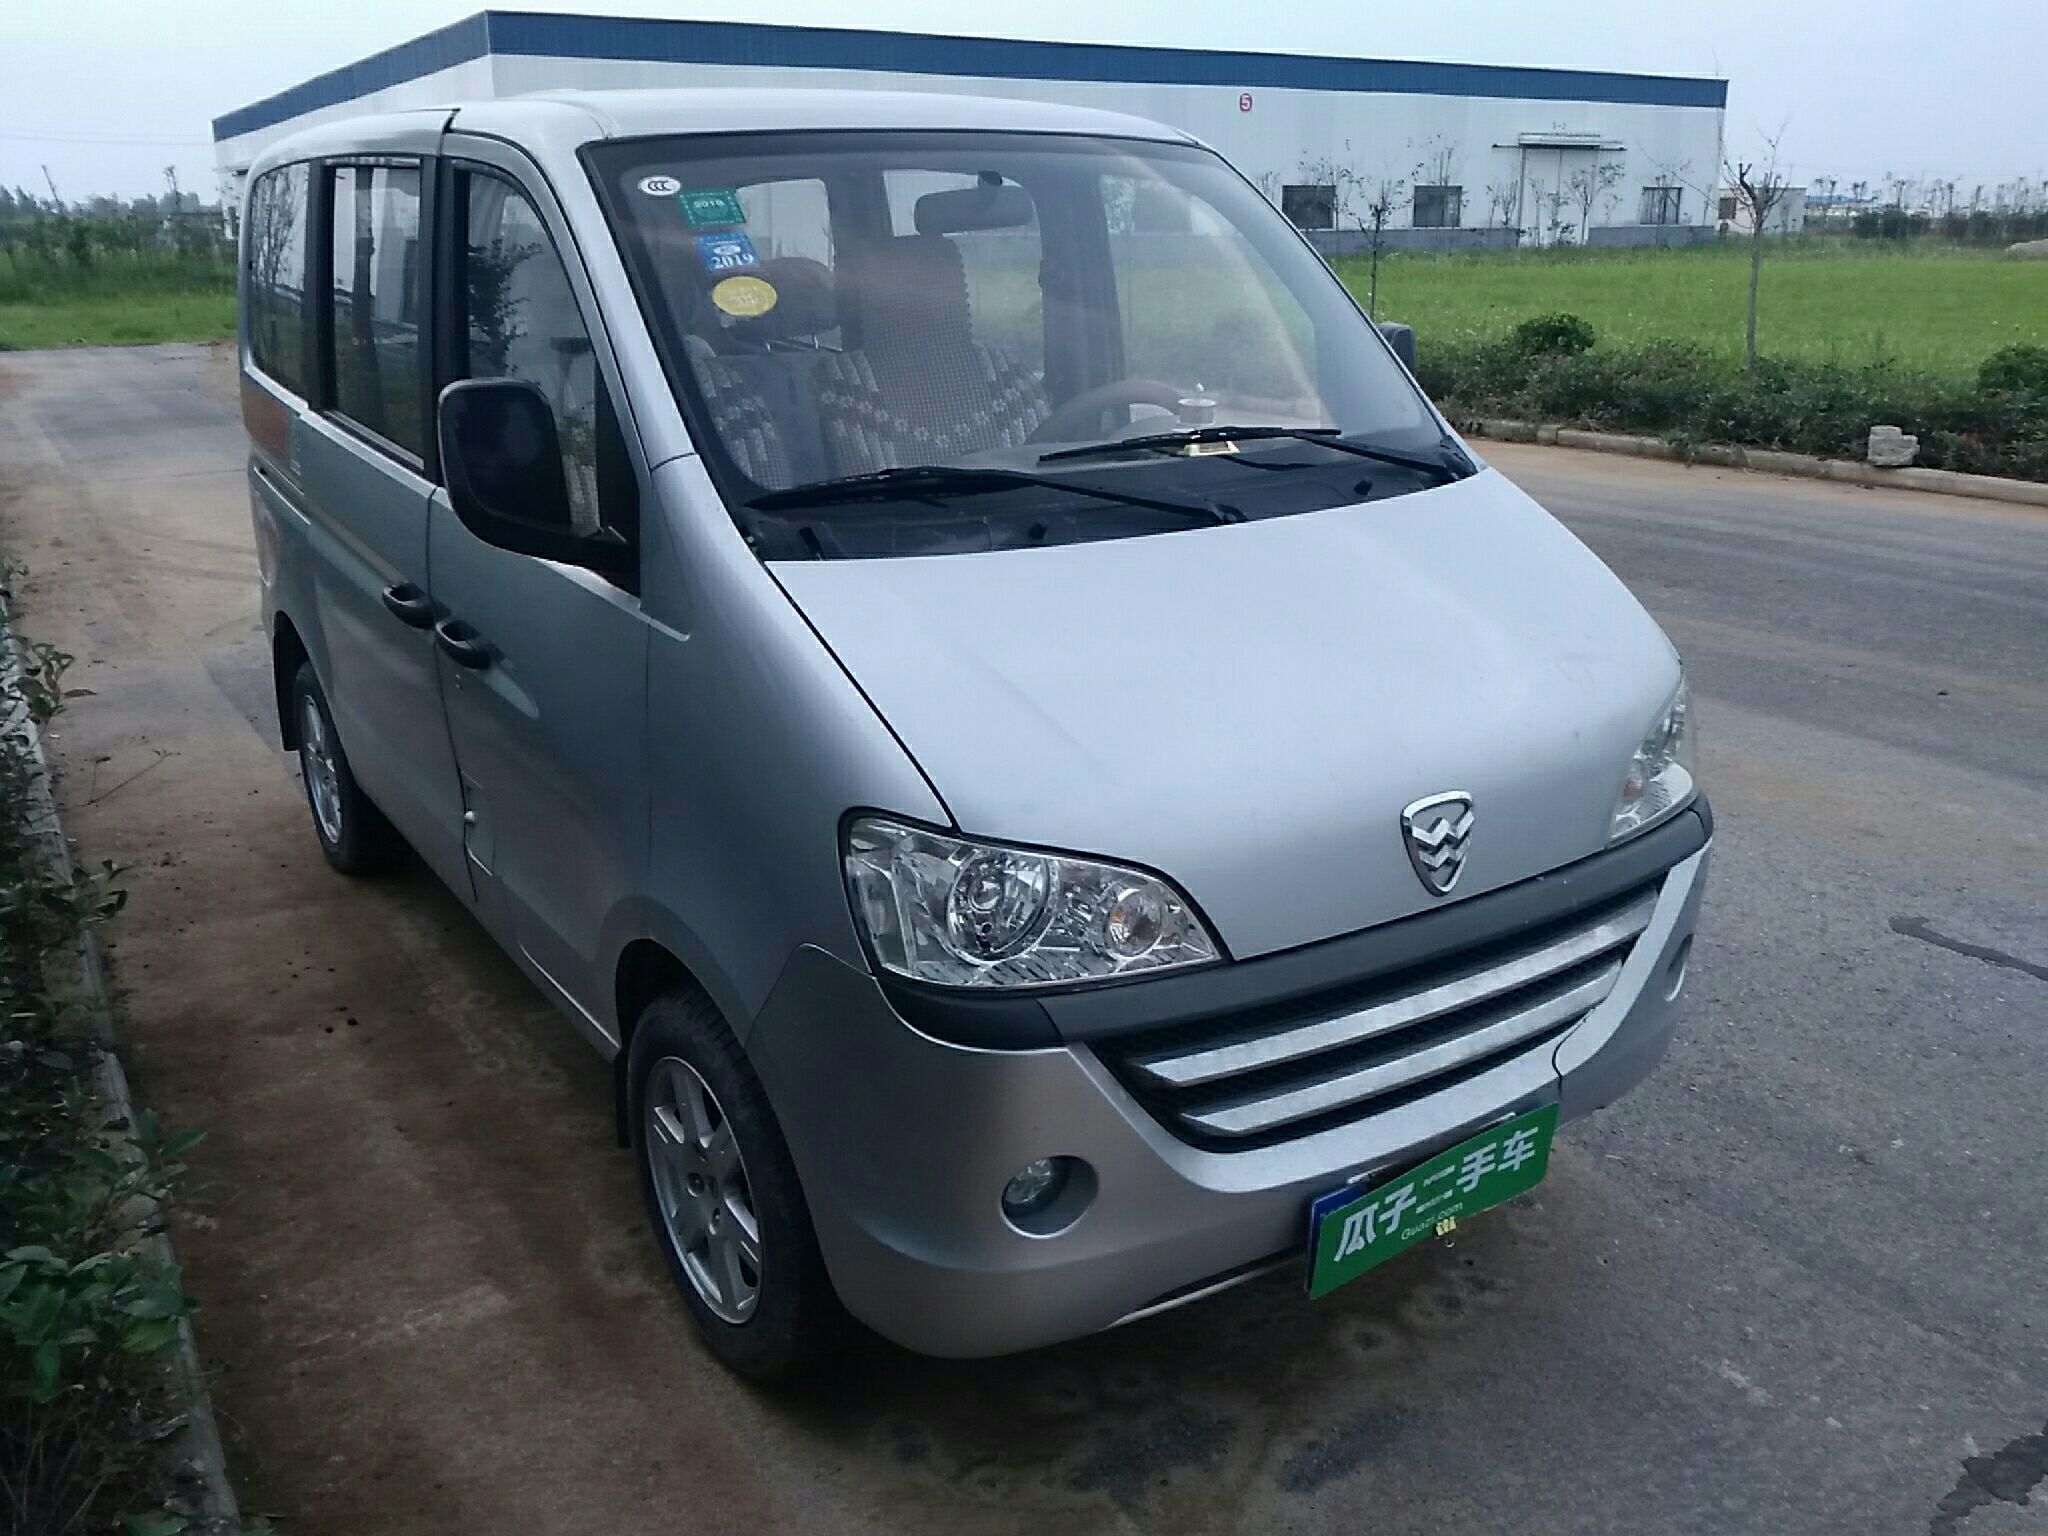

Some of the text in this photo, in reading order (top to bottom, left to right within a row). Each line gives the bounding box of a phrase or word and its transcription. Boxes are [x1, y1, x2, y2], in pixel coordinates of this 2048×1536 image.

[1241, 94, 1251, 110] 5
[712, 253, 754, 269] 2019
[1334, 1127, 1539, 1262] 瓜子二手车
